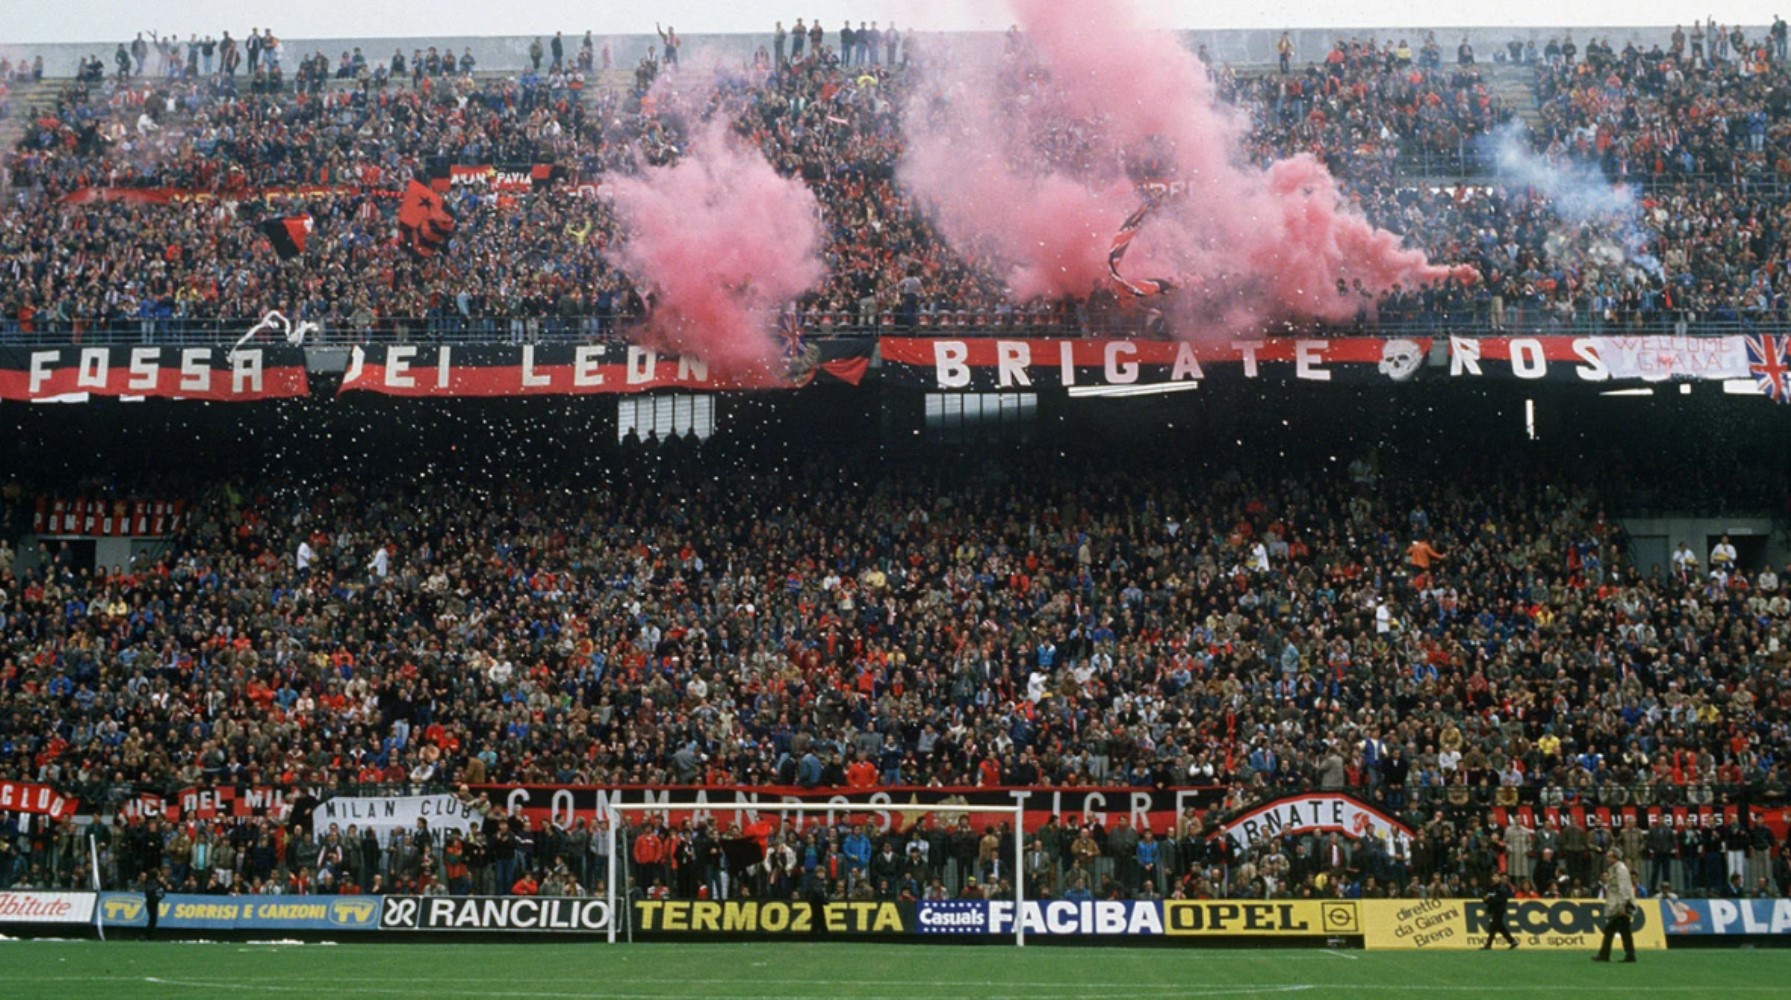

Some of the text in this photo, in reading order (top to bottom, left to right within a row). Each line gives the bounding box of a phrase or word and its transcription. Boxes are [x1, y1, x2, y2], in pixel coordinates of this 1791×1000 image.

[496, 171, 533, 185] PAVIA
[1612, 336, 1732, 353] WELCOME
[28, 346, 264, 393] FOSSA
[933, 340, 1332, 388] BRIGATE
[183, 789, 227, 812] DEL
[326, 798, 471, 820] MILAN CLUB
[104, 901, 142, 920] TV
[175, 903, 238, 920] SORRISI
[243, 904, 253, 920] E
[258, 904, 326, 920] CANZONI
[334, 904, 373, 924] TV
[428, 899, 611, 929] RANCILIO
[919, 900, 1164, 934] Casuals FACIBA
[1170, 903, 1309, 931] OPEL
[1396, 898, 1442, 922] diretto
[1394, 905, 1460, 938] da Gianni
[1413, 926, 1454, 948] Brera
[1528, 935, 1541, 946] di
[1547, 935, 1585, 947] sport
